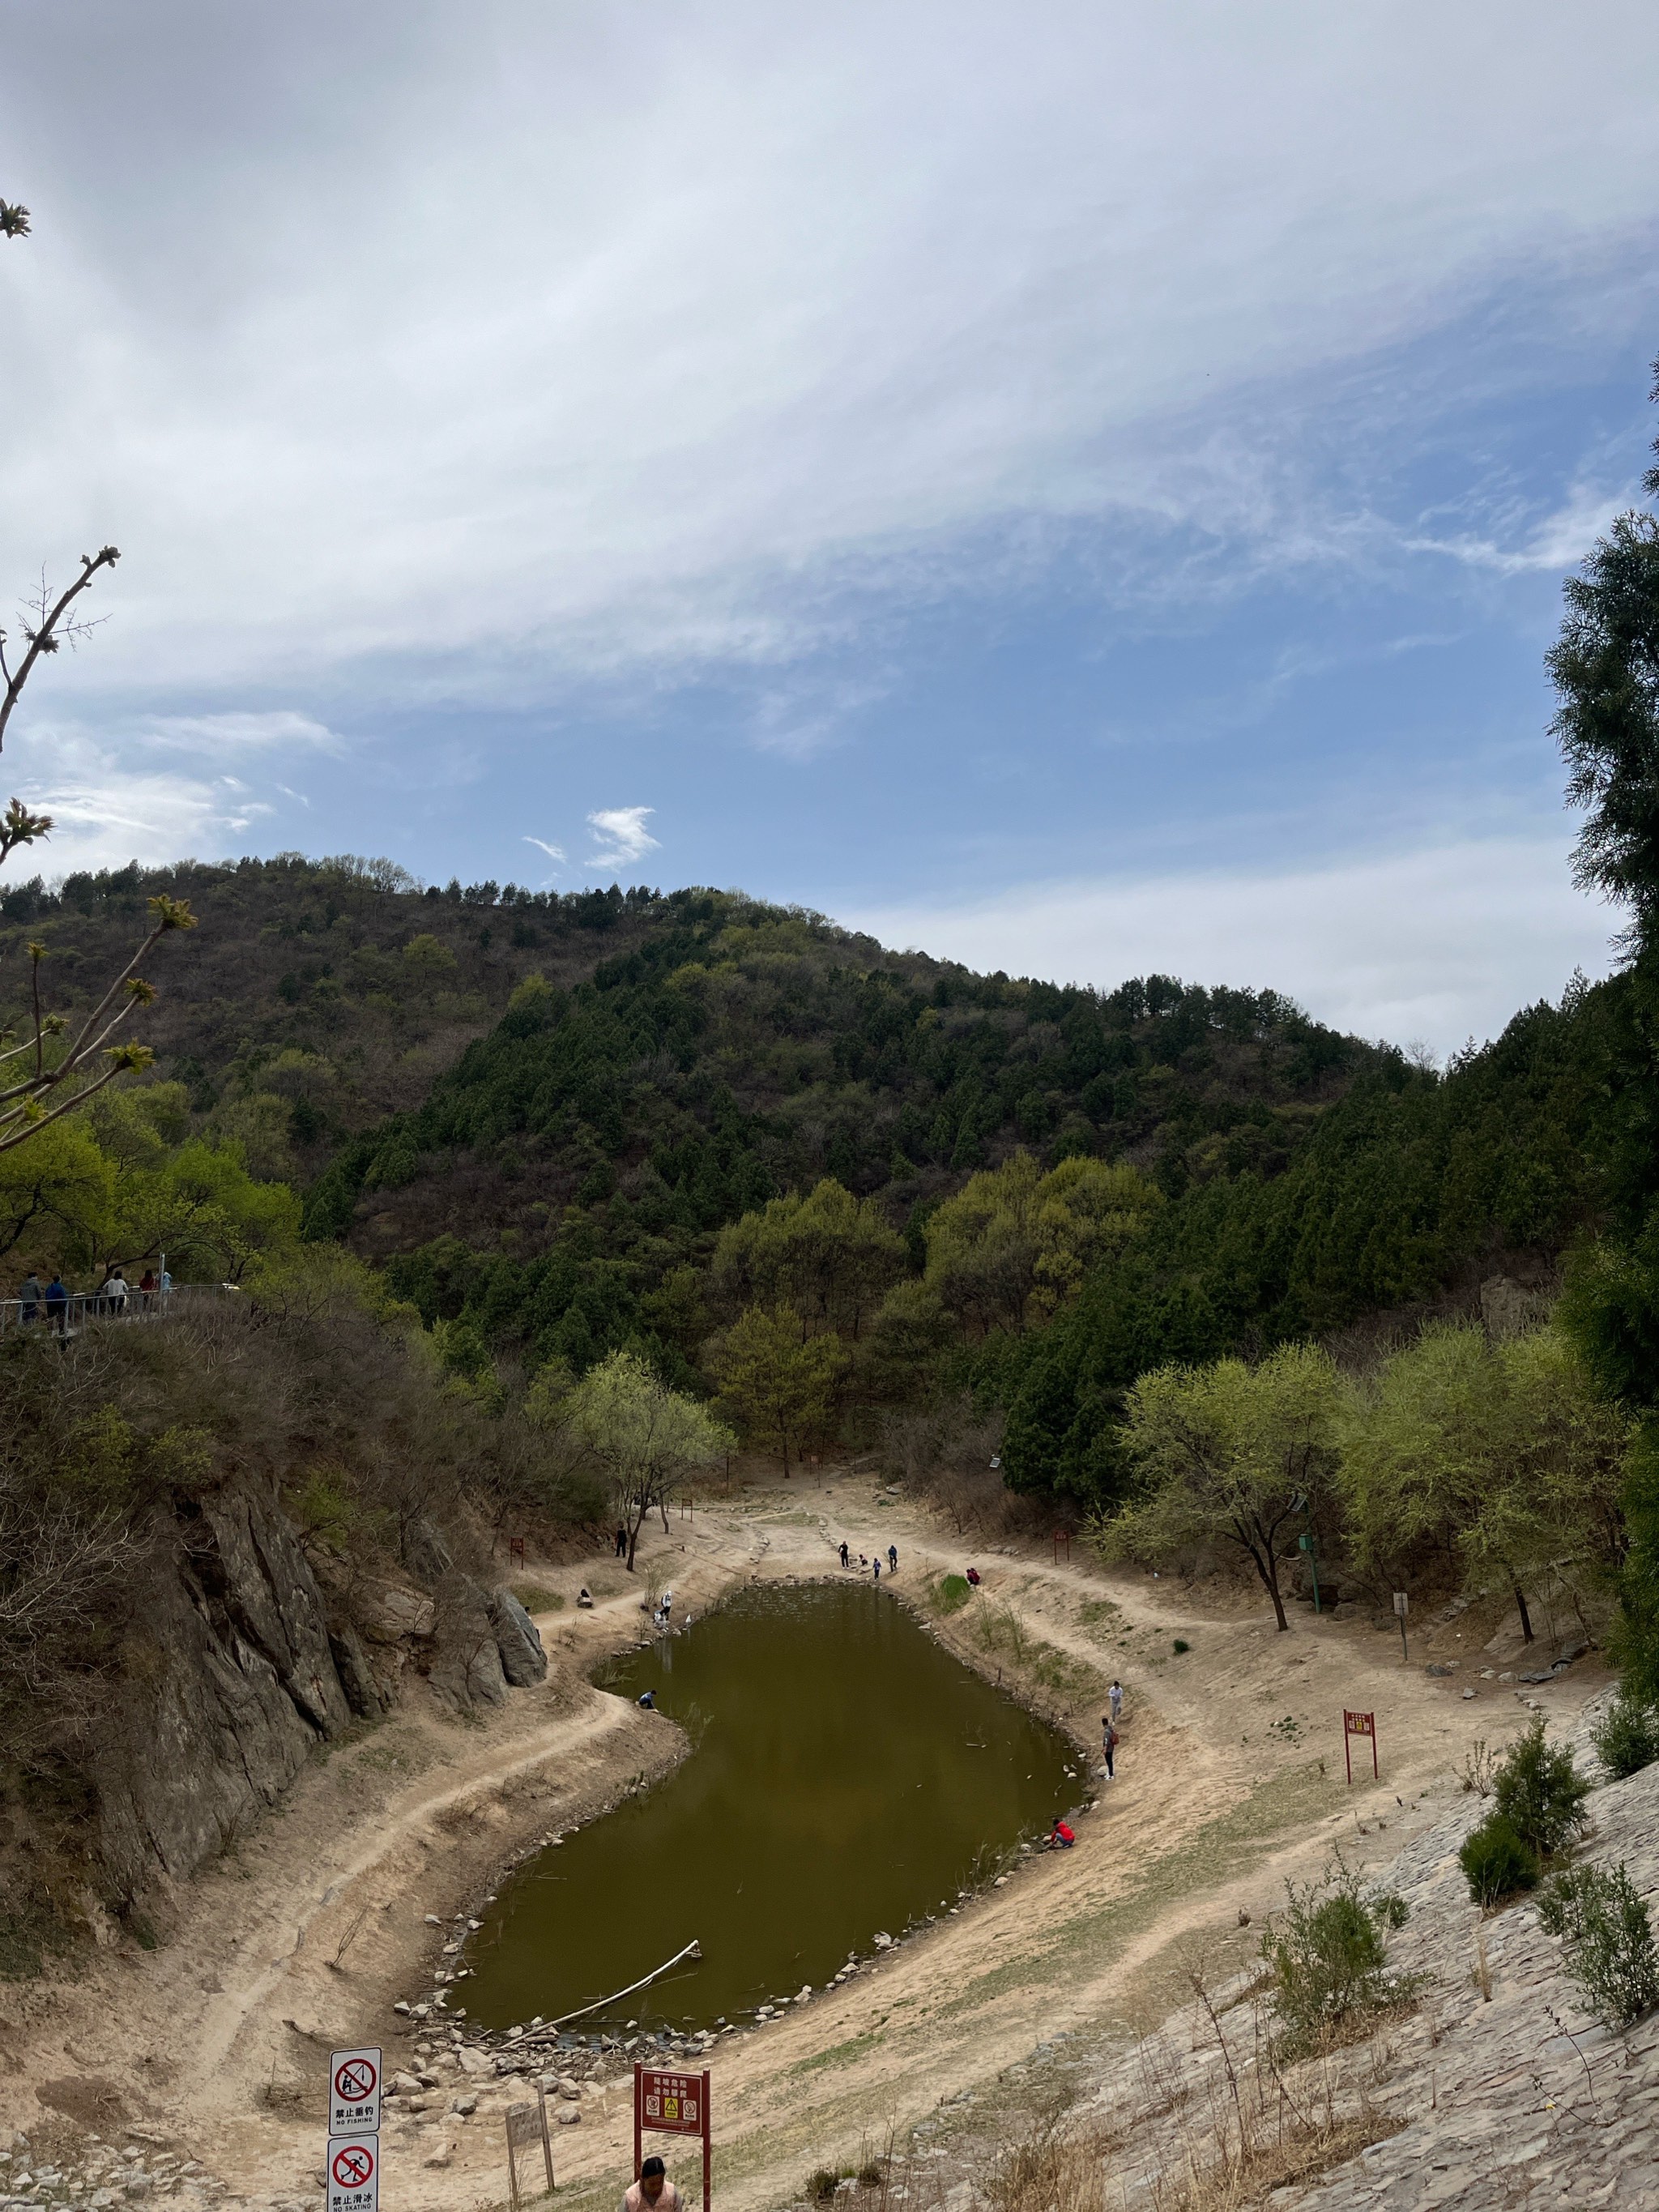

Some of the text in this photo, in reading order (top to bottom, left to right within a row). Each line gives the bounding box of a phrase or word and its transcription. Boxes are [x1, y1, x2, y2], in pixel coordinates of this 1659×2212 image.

[654, 2086, 687, 2099] 请勿攀爬
[335, 2106, 373, 2119] 禁止垂钓
[347, 2116, 373, 2124] FISHING
[332, 2192, 373, 2206] 禁止滑冰
[344, 2203, 372, 2212] SKATING
